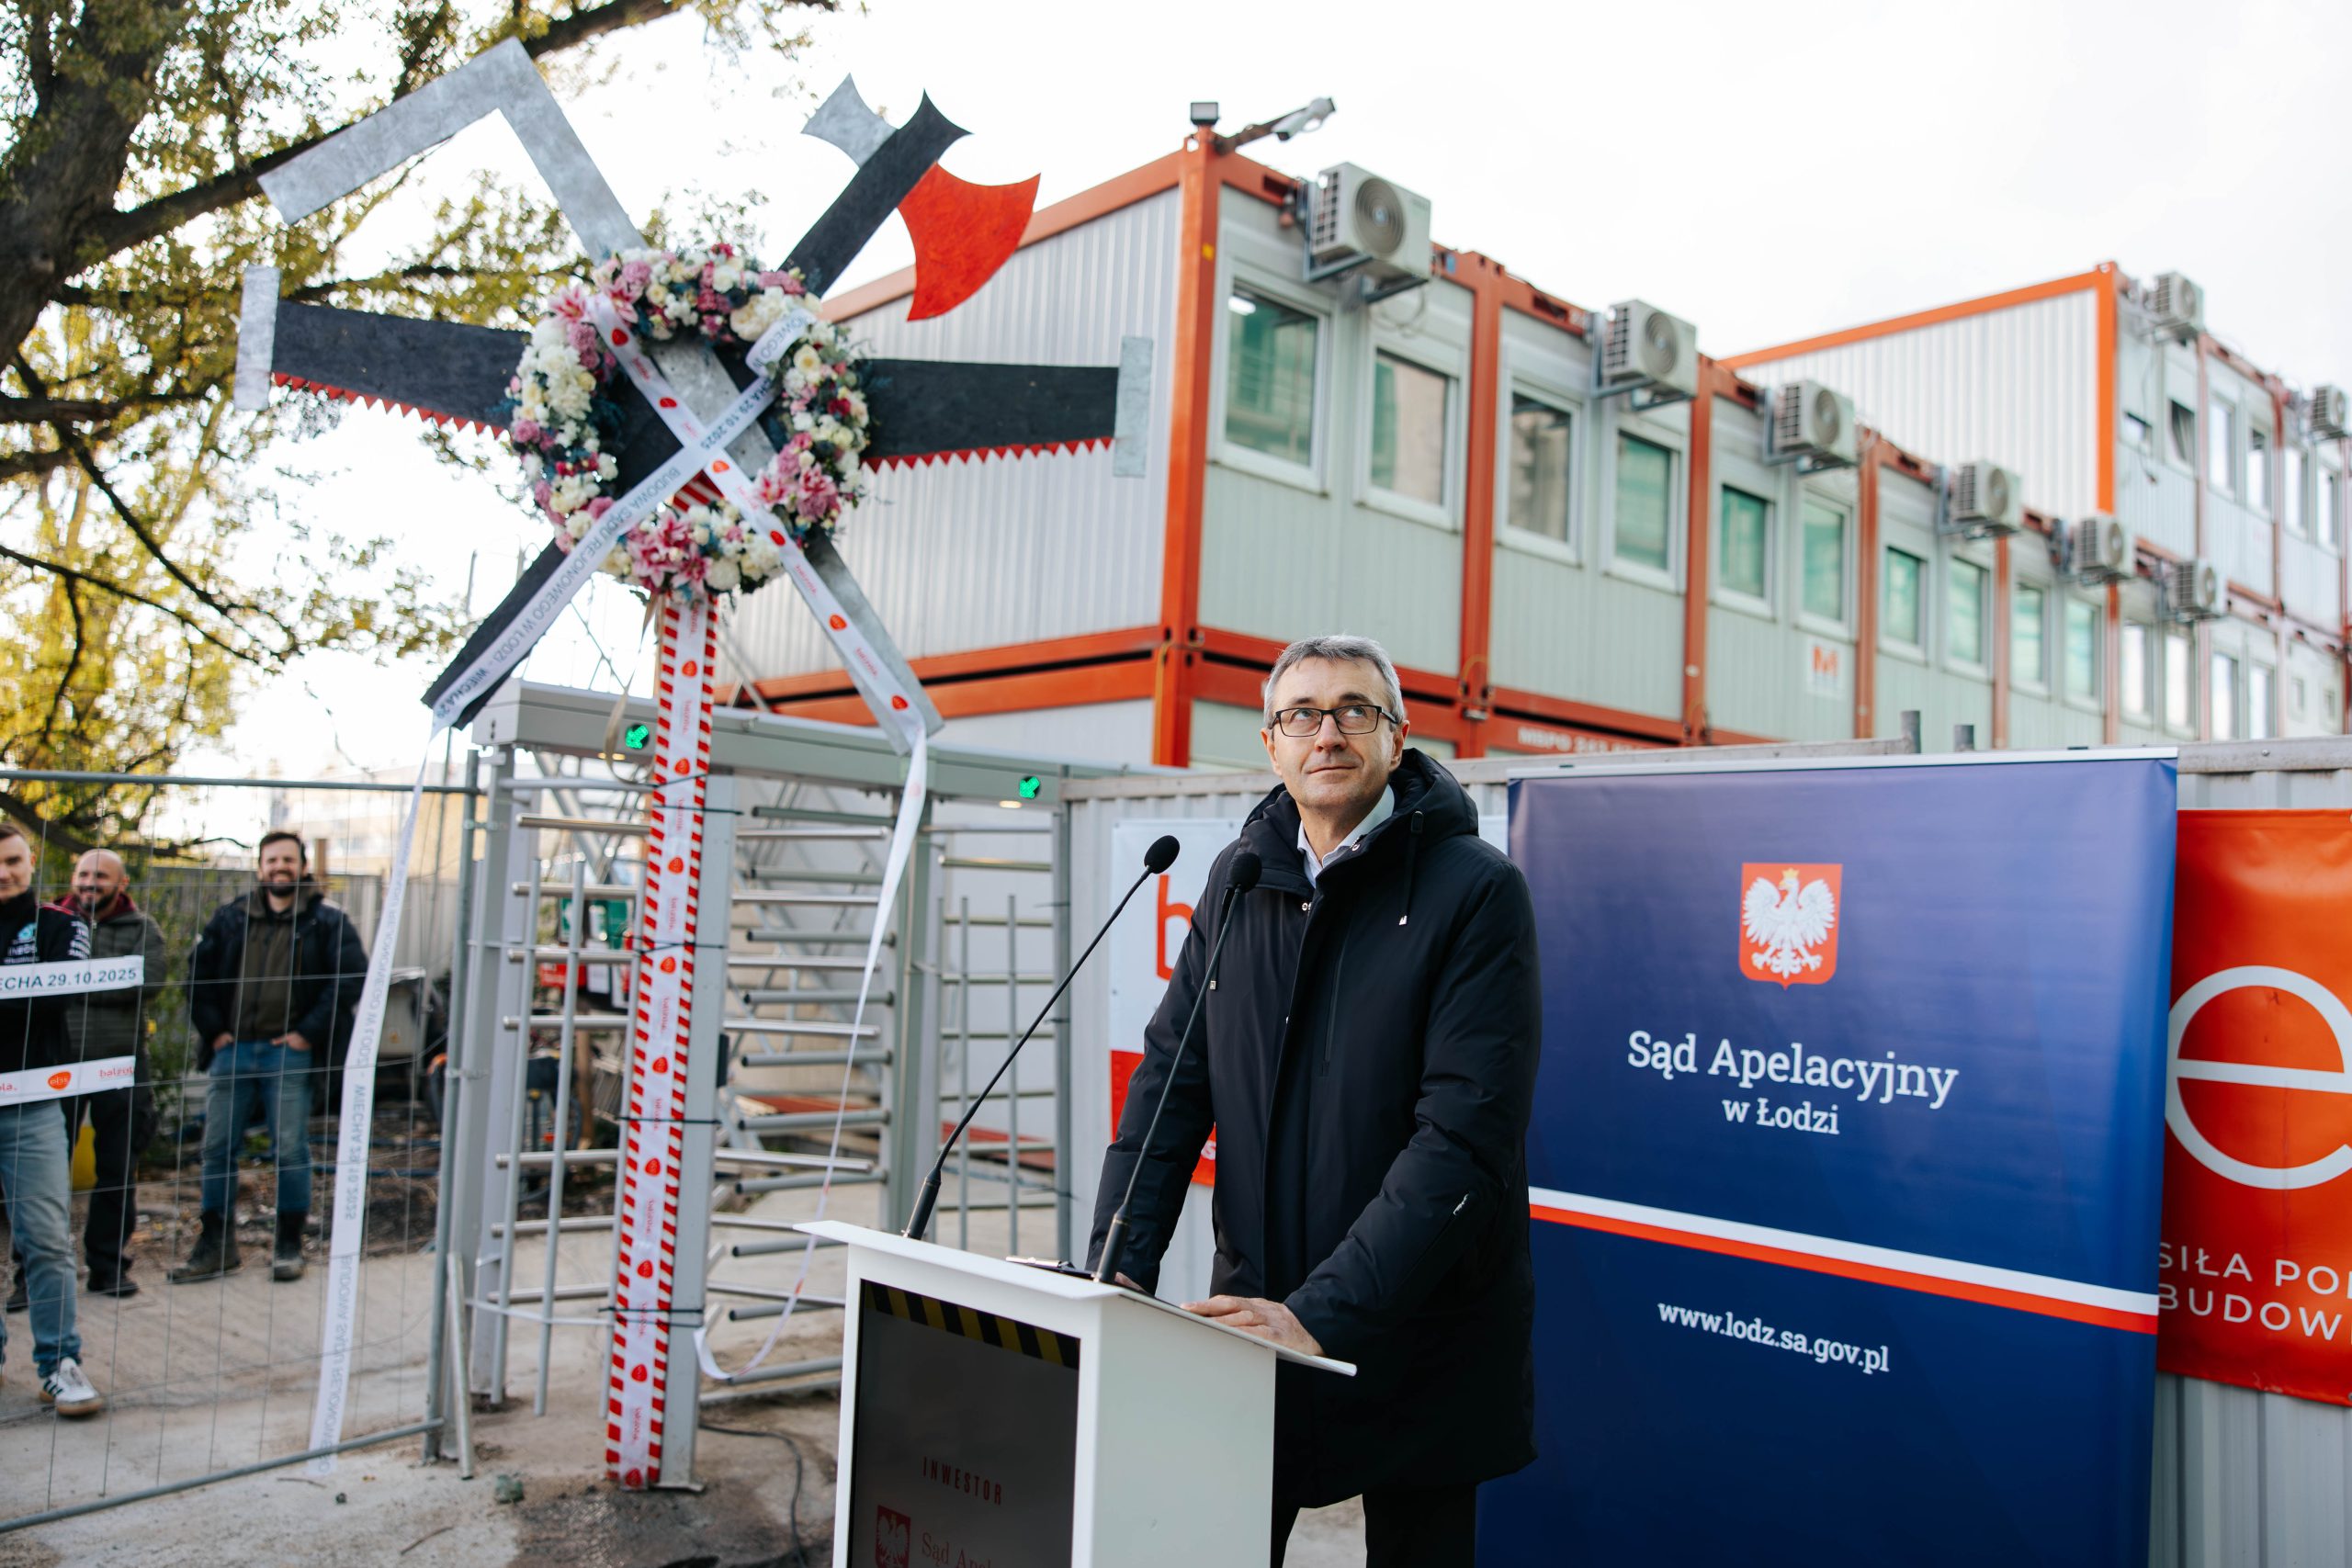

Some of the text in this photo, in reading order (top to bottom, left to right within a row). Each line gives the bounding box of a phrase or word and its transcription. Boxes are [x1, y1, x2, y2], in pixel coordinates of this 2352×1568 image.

[631, 467, 681, 510] BUDOWA
[601, 508, 632, 538] SĄDU
[533, 536, 603, 621] REJONOWEGO
[493, 629, 526, 663] ŁODZI
[522, 619, 537, 634] W
[447, 669, 489, 707] WIECHA
[47, 967, 137, 987] 29.10.2025
[1628, 1030, 1959, 1110] Sąd Apelacyjny
[1722, 1097, 1840, 1135] w Łodzi
[2159, 1241, 2253, 1282] SIŁA
[2159, 1283, 2352, 1344] BUDOW
[1657, 1303, 1890, 1375] www.lodz.sa.gov.pl
[922, 1456, 1001, 1506] INWESTOR
[922, 1532, 950, 1567] Sąd
